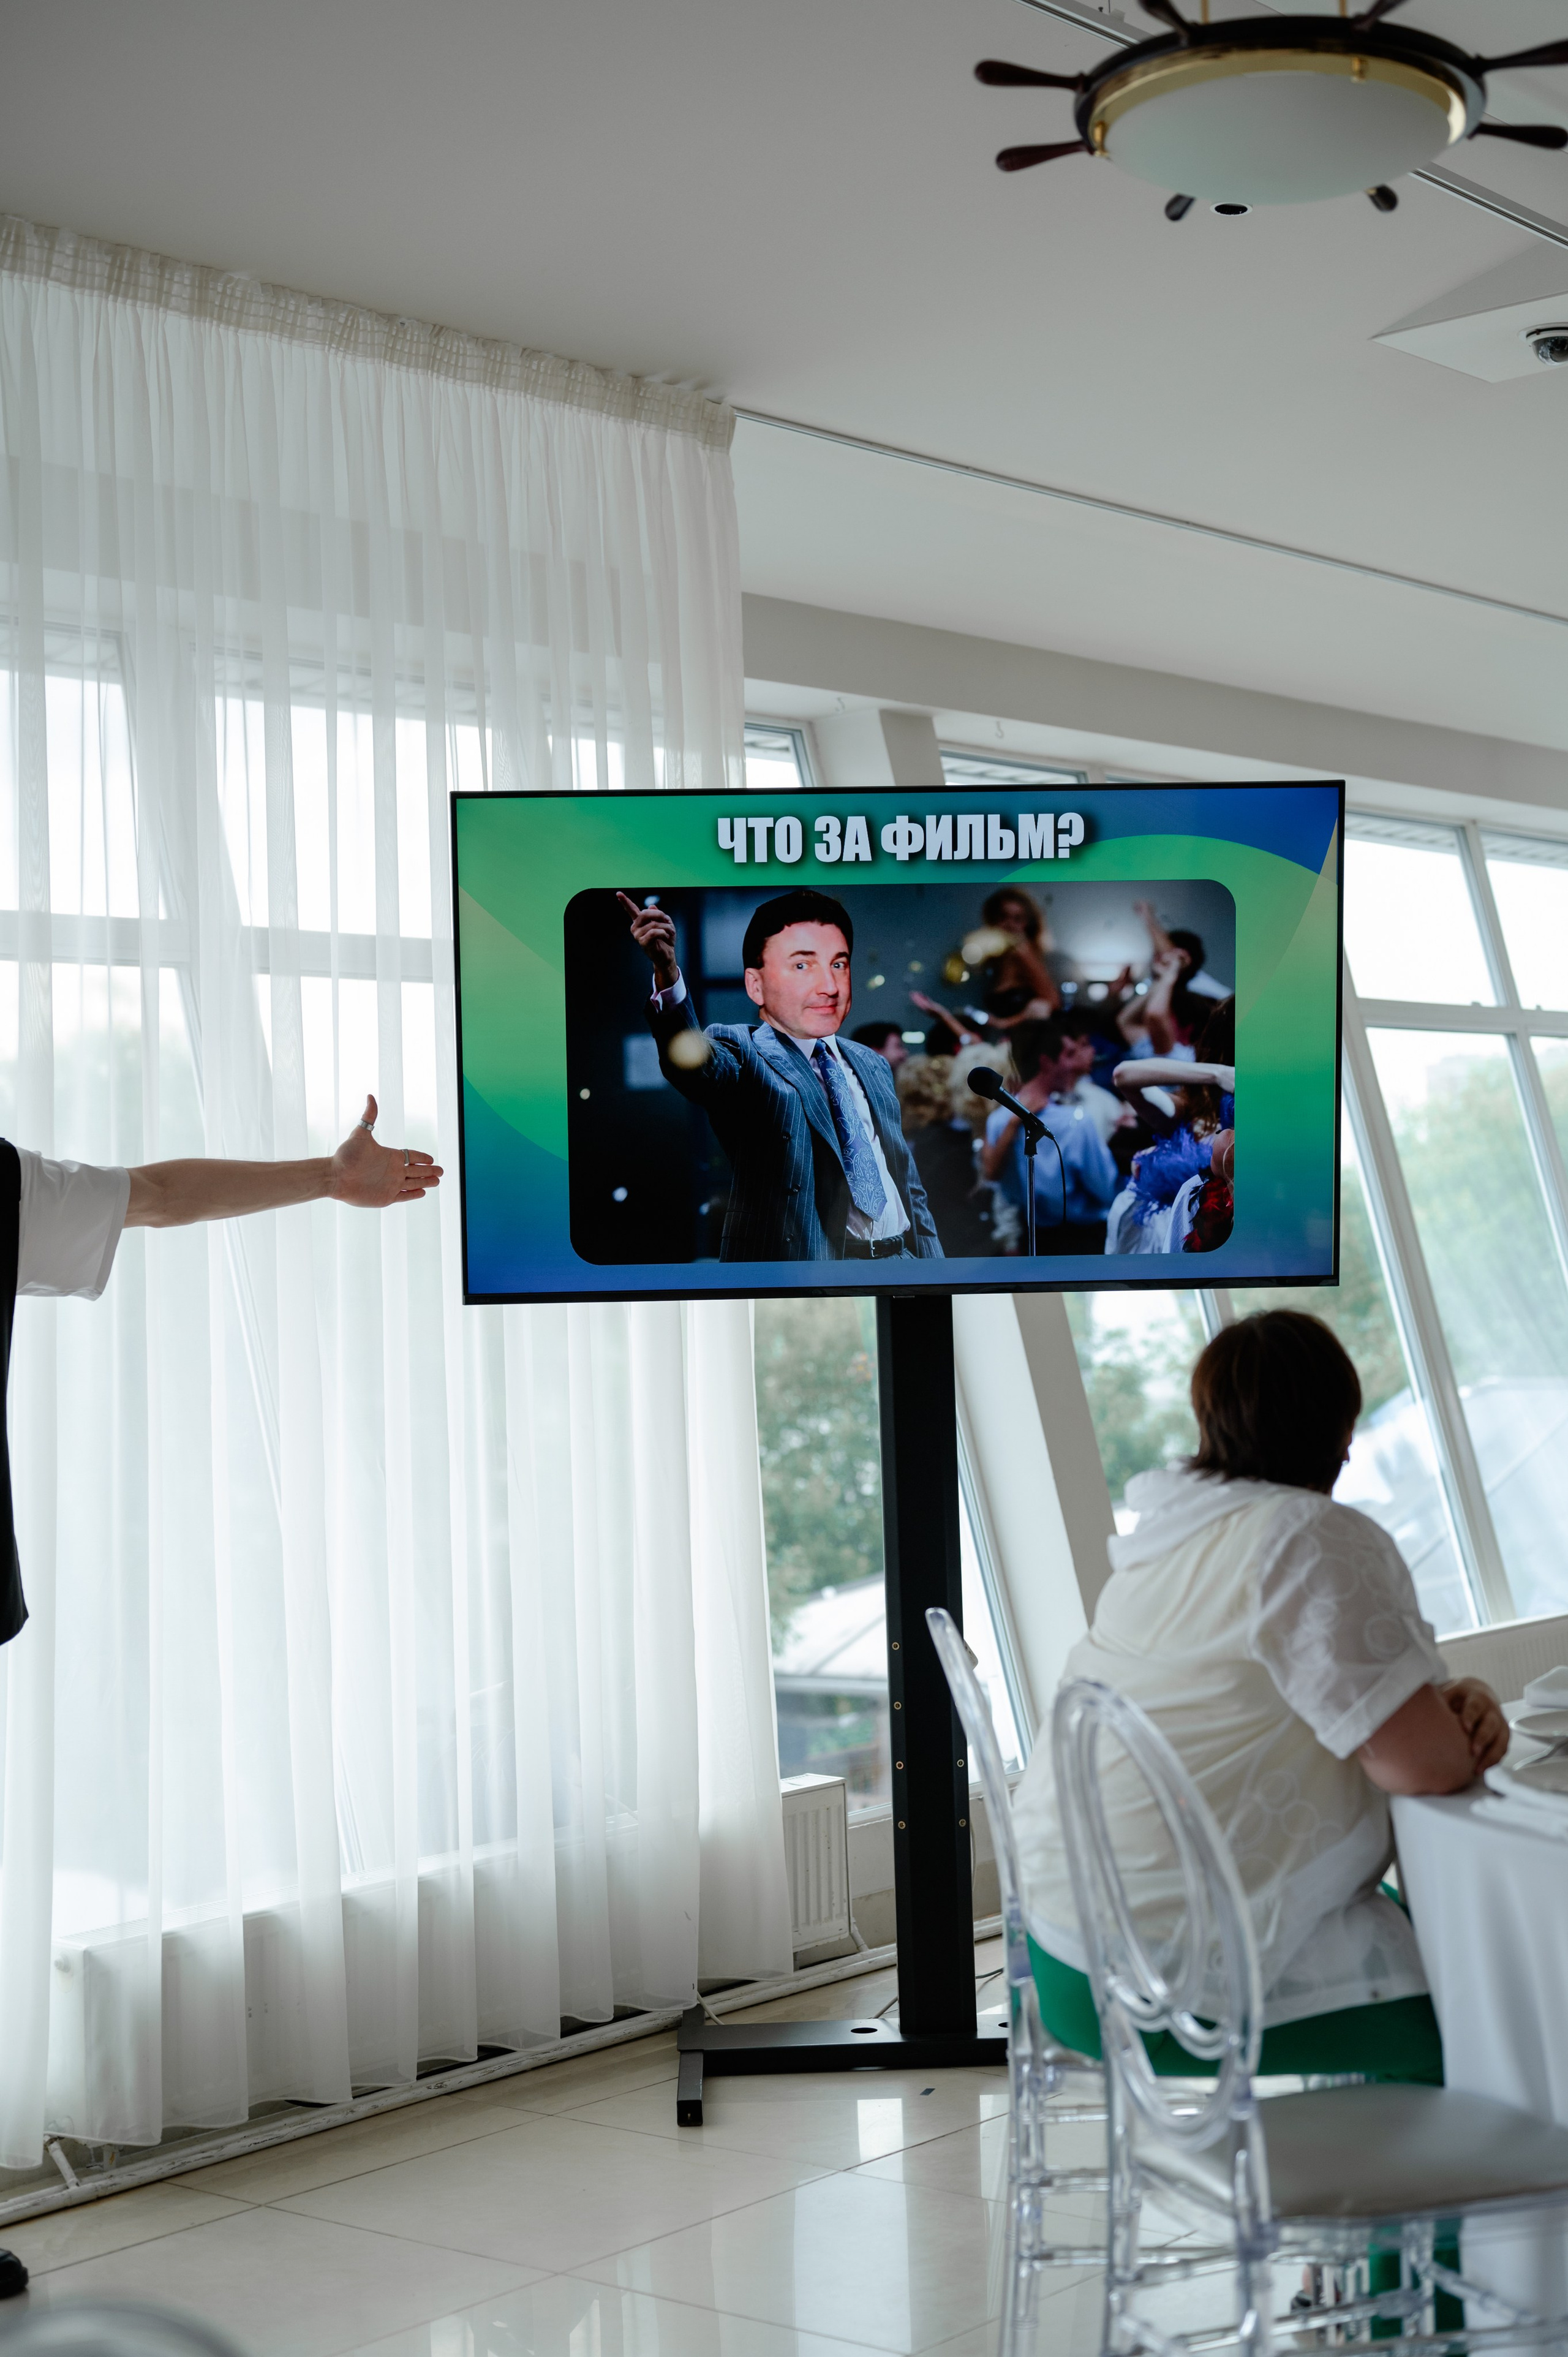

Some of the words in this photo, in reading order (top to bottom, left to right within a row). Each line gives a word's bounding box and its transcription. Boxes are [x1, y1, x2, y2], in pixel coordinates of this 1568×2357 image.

[717, 816, 802, 863] ЧТО
[814, 815, 872, 861] ЗА
[881, 812, 1085, 861] ФИЛЬМ?
